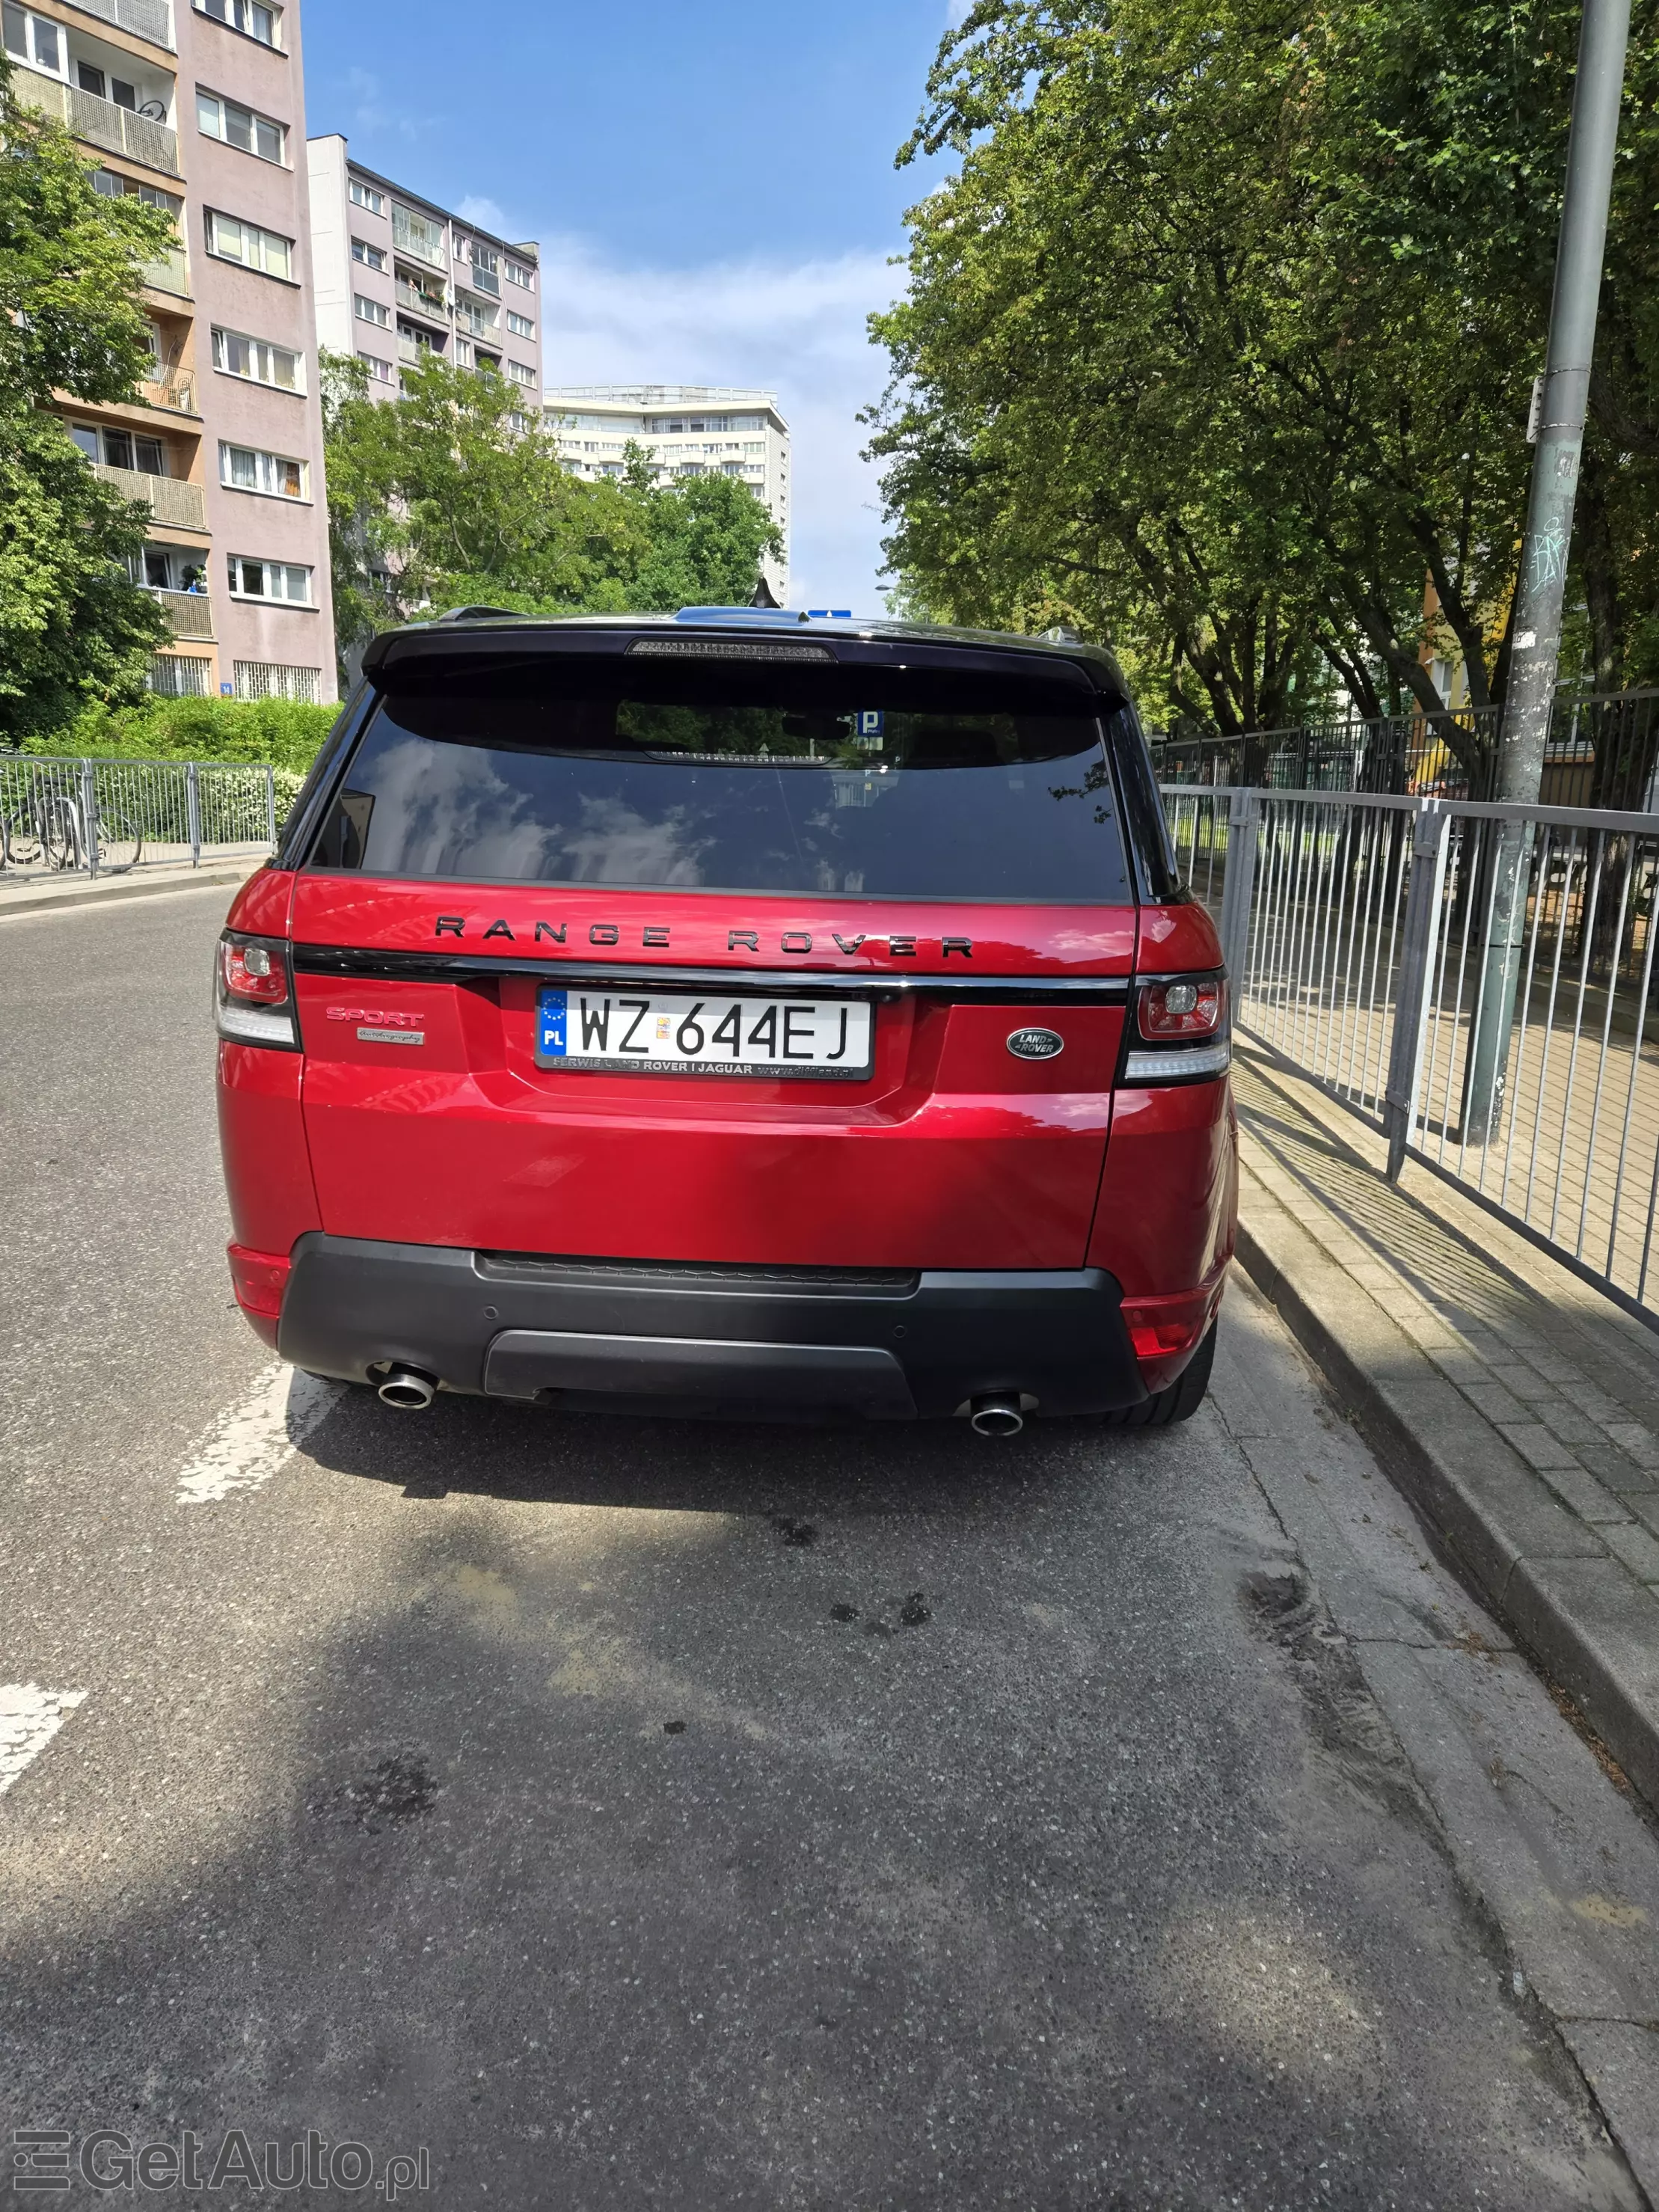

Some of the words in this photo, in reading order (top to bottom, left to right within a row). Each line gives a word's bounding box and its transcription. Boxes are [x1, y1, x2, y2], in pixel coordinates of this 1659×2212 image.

[862, 711, 879, 734] P
[435, 916, 671, 948] RANGE
[727, 930, 974, 958] ROVER
[326, 1006, 425, 1027] SPORT
[544, 1030, 564, 1046] PL
[580, 997, 650, 1053] WZ
[676, 1002, 847, 1060] 644EJ
[1019, 1034, 1047, 1044] LAND
[1019, 1043, 1054, 1053] ROVER
[552, 1056, 601, 1068] SERWIS
[604, 1058, 640, 1070] LAND
[643, 1061, 688, 1072] ROVER
[698, 1064, 753, 1074] JAGUAR
